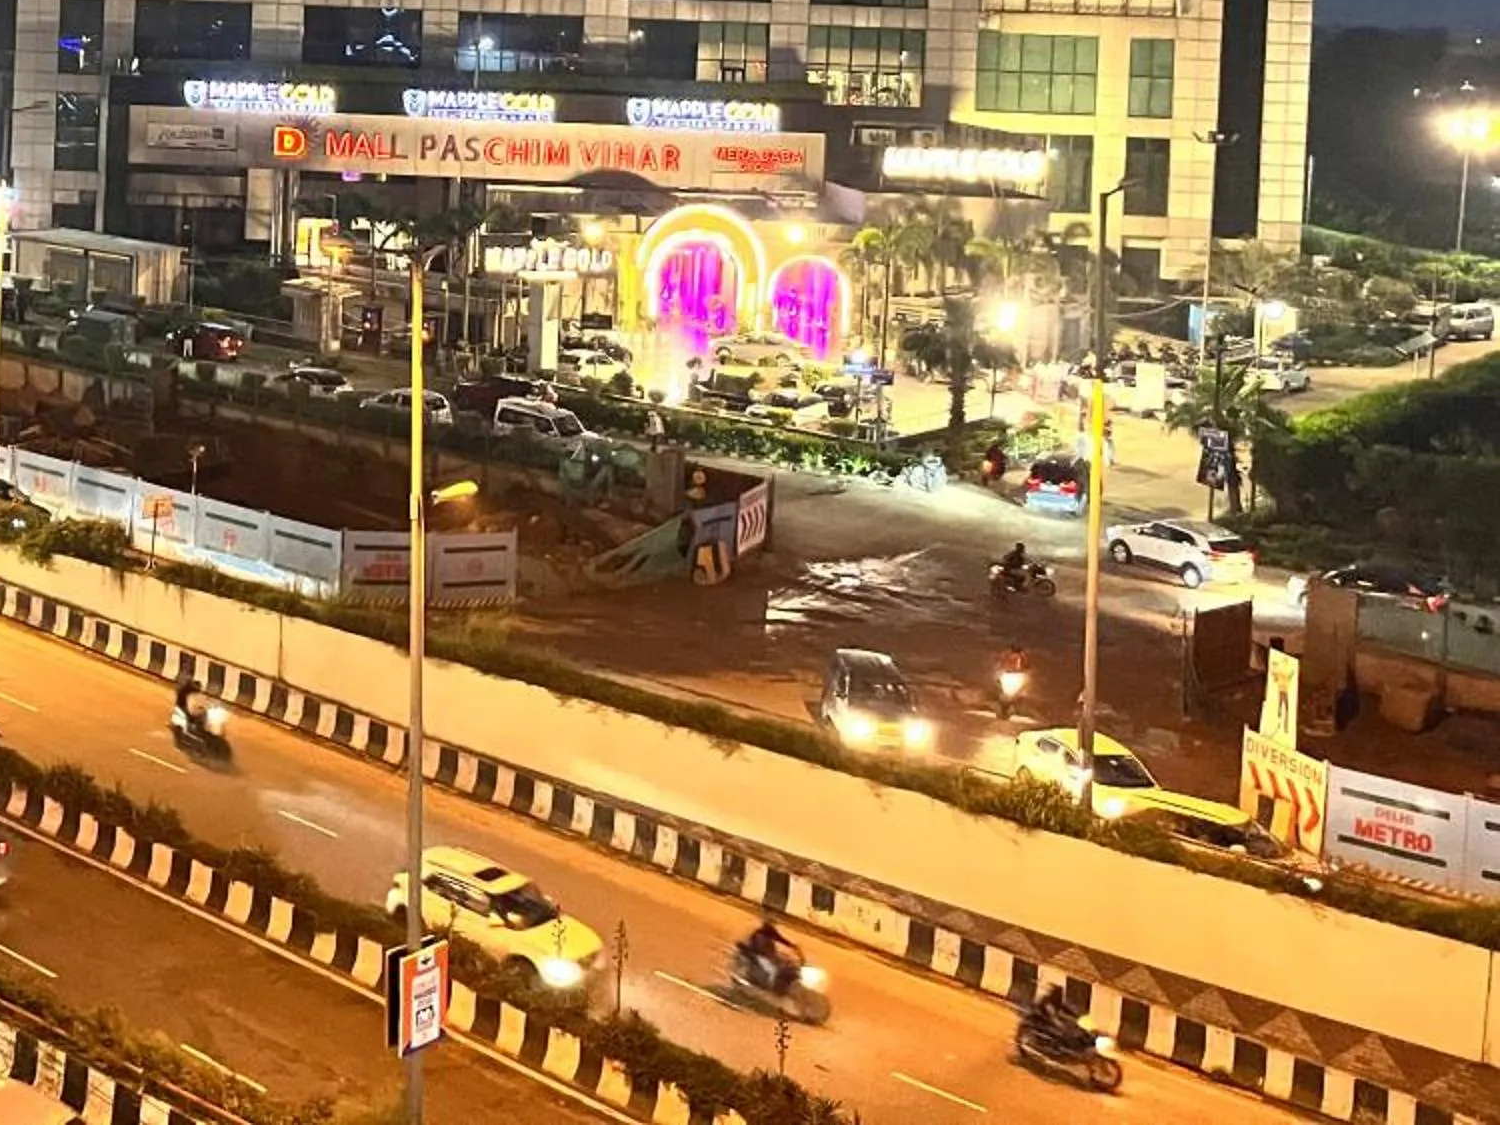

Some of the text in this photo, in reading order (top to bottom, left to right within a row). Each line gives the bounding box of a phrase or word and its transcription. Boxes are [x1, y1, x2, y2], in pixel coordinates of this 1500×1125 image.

[209, 80, 280, 101] MAPPLE
[279, 83, 336, 106] GOLD
[427, 90, 555, 113] MAPPLE GOLD
[650, 98, 724, 119] MAPPLE
[324, 129, 409, 161] MALL
[419, 133, 570, 167] PASCHIM
[578, 139, 681, 172] VIHAR
[1245, 736, 1323, 786] DIVERSION
[1373, 806, 1415, 826] DELHI
[1353, 818, 1434, 854] METRO
